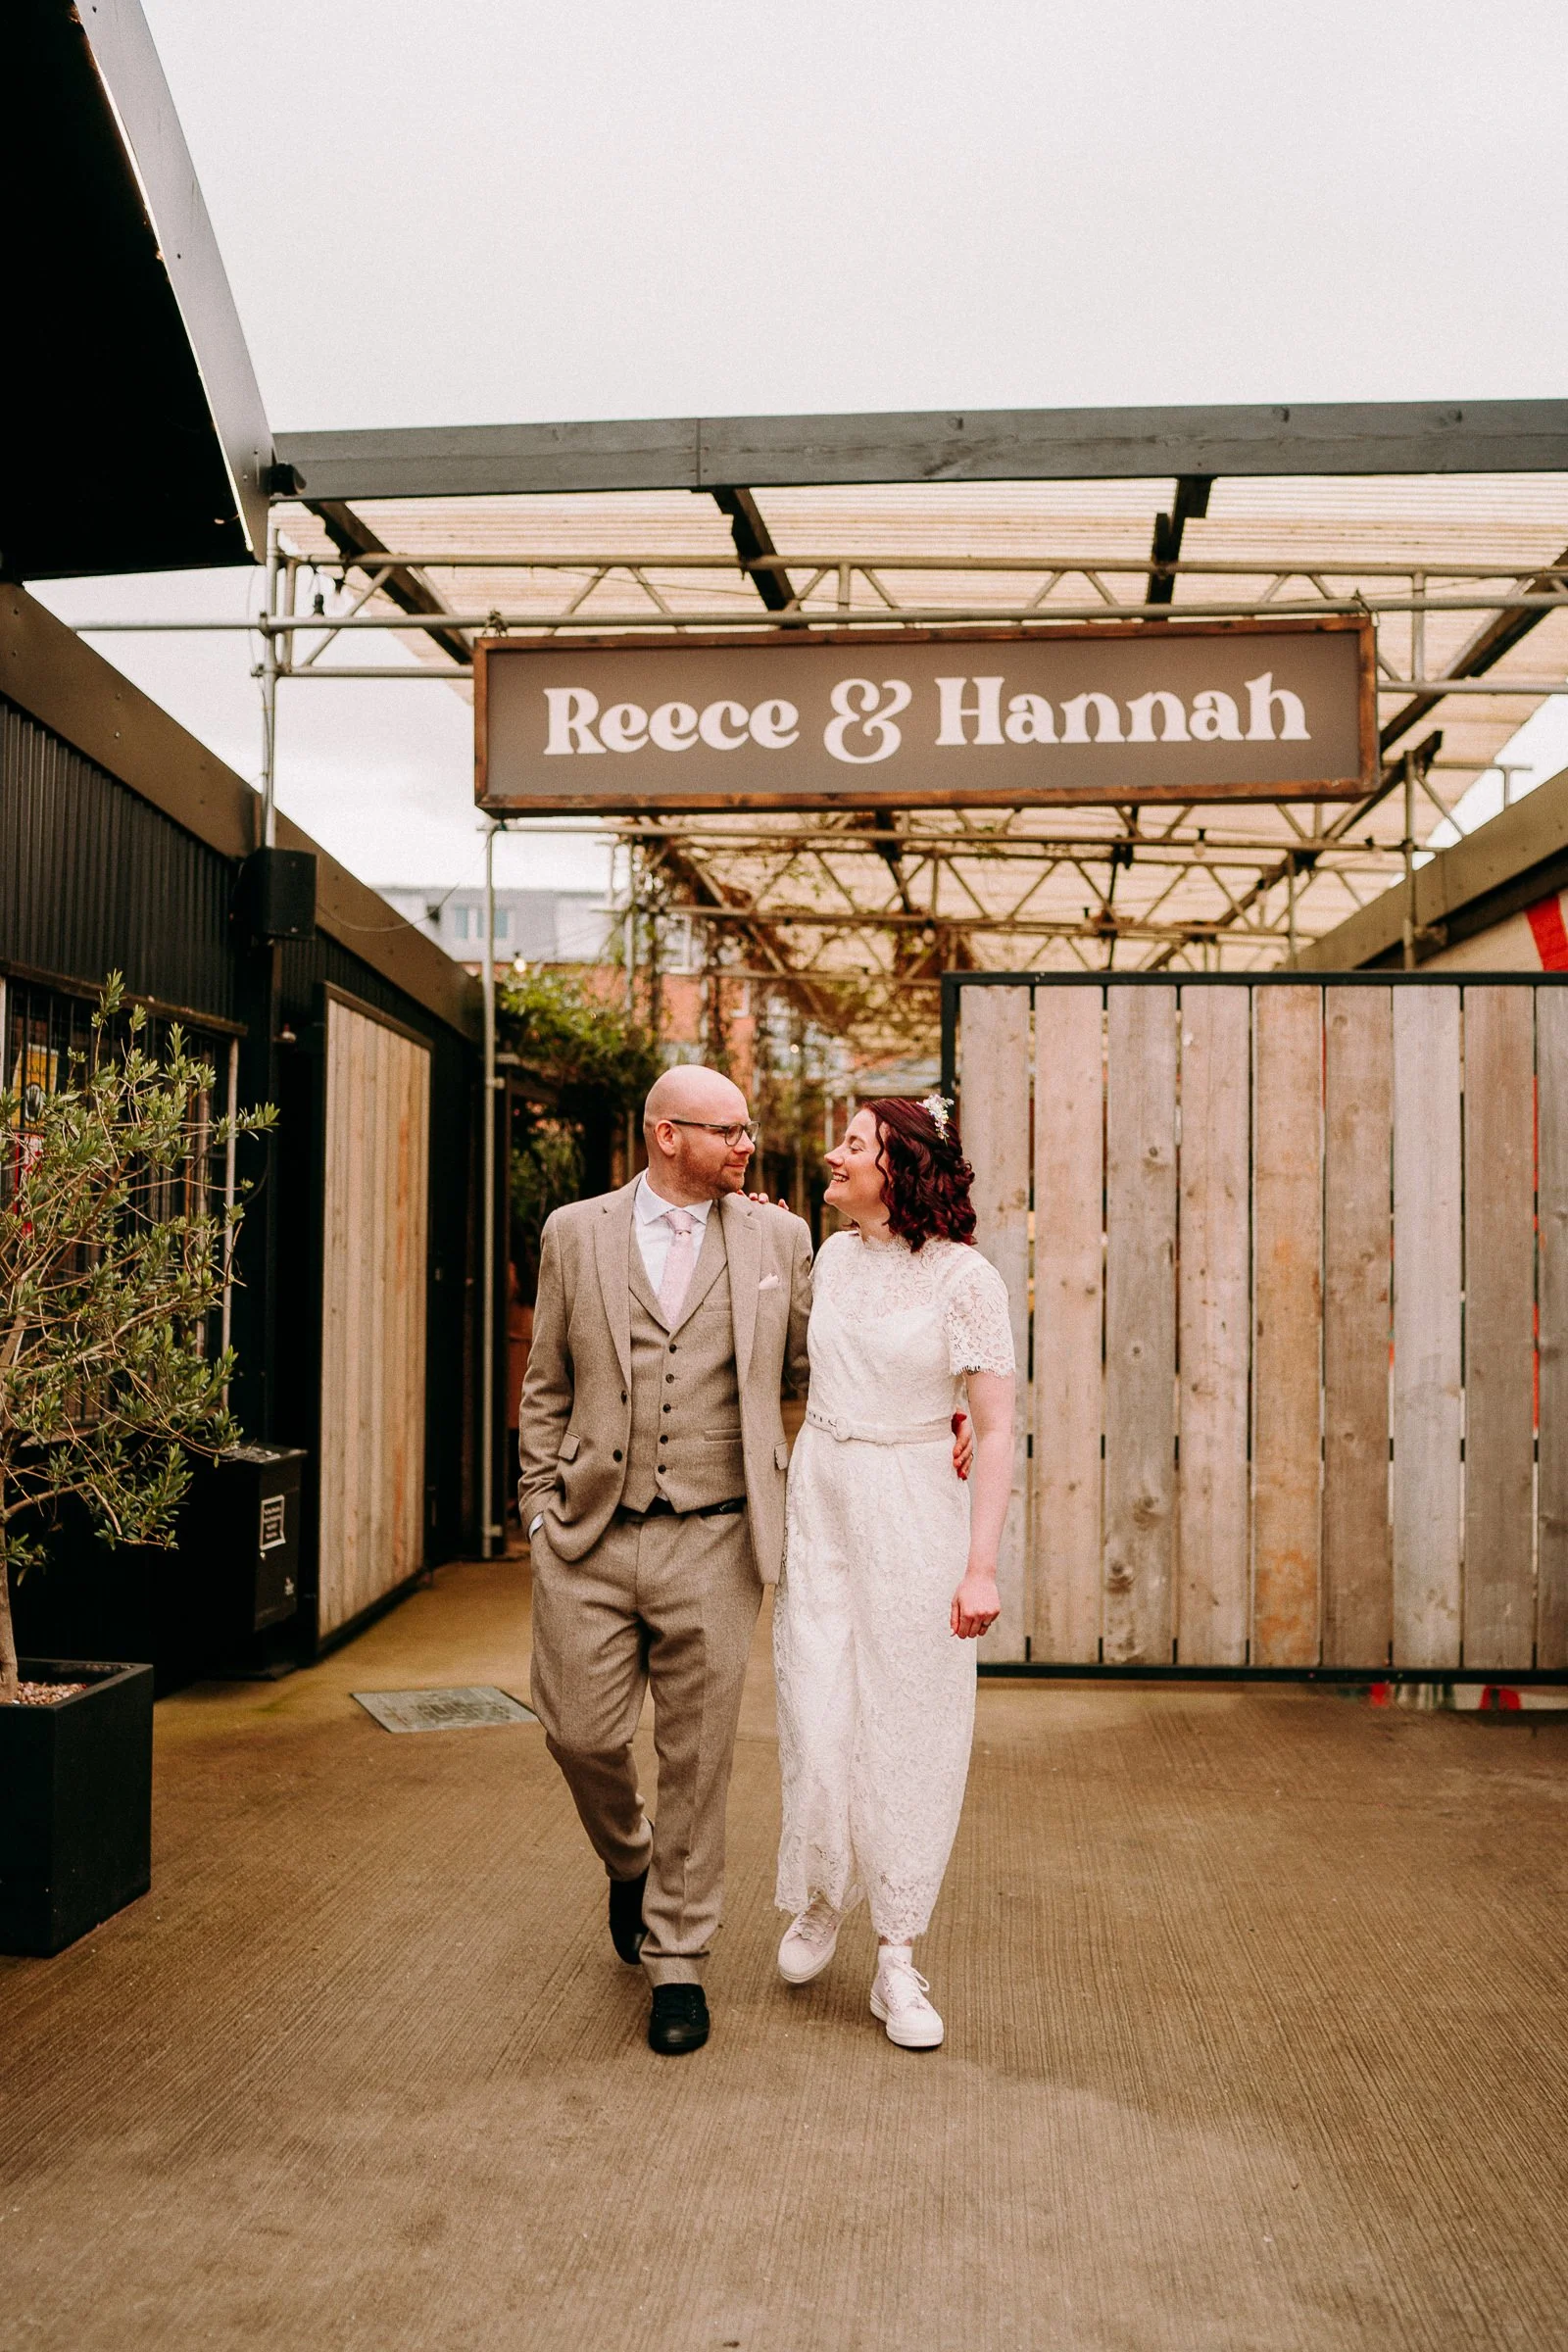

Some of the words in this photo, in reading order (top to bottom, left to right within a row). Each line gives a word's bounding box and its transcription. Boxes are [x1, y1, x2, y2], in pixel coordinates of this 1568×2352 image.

[543, 687, 801, 756] Reece
[822, 678, 912, 764] &
[934, 671, 1311, 746] Hannah
